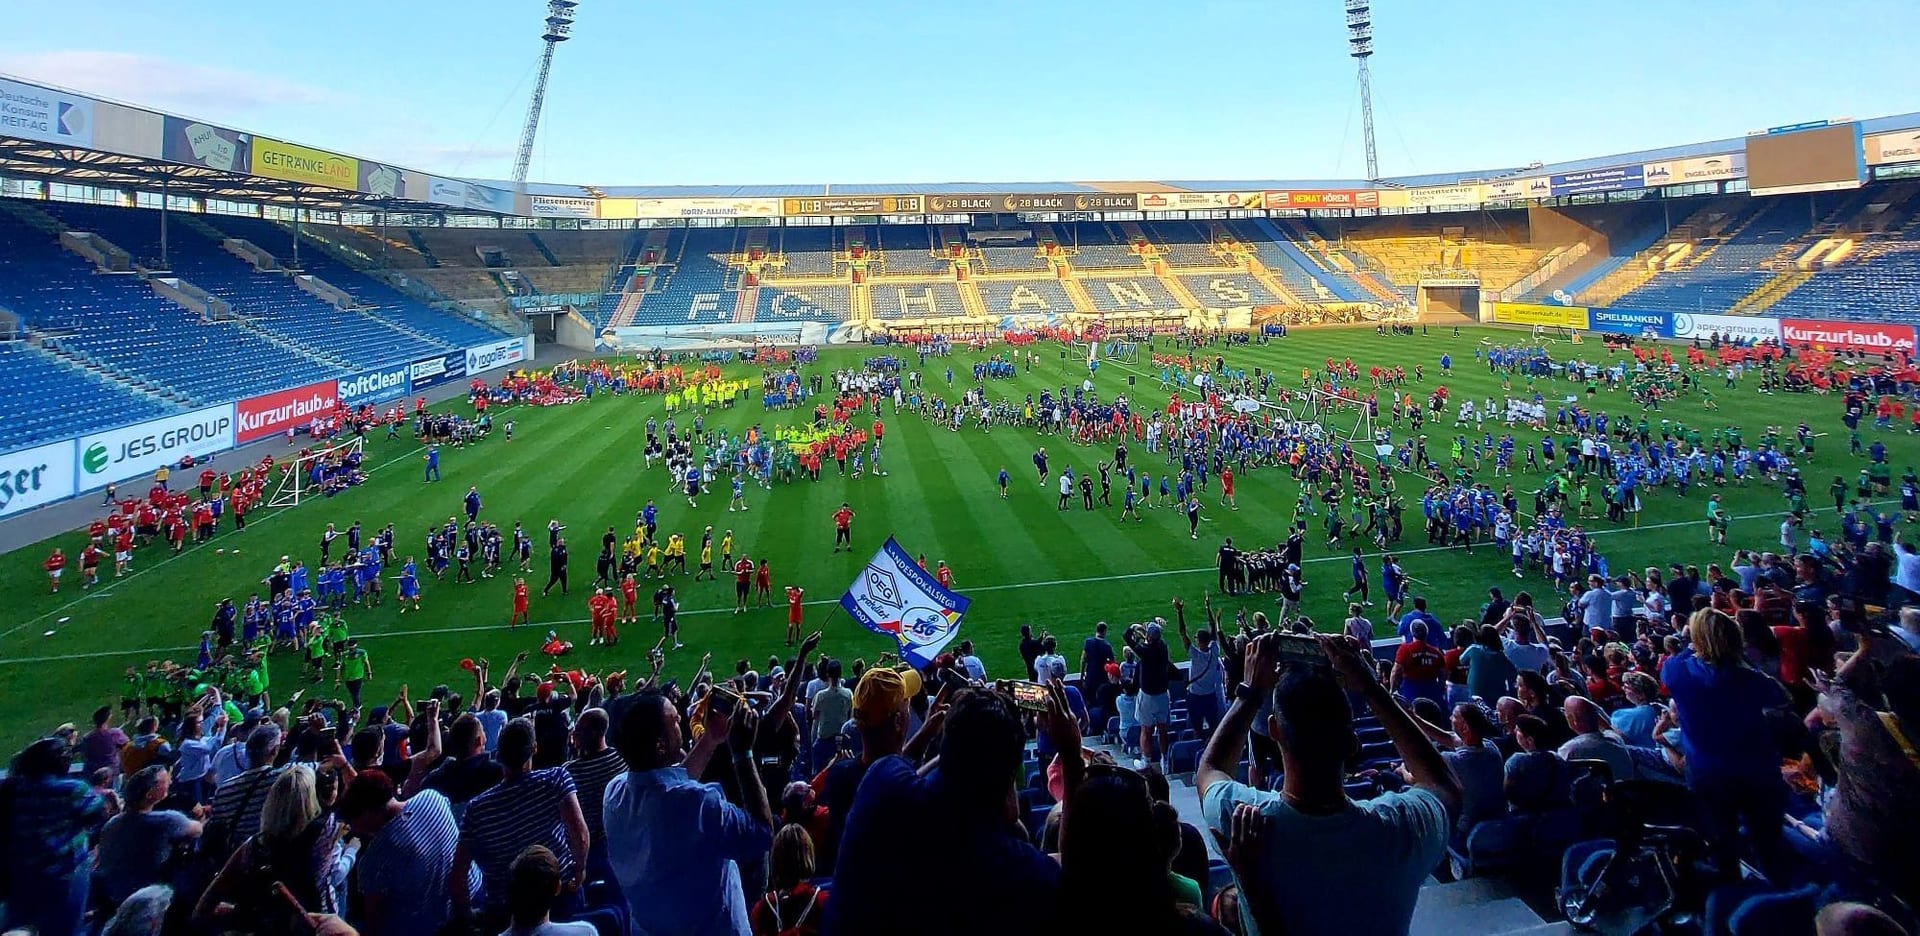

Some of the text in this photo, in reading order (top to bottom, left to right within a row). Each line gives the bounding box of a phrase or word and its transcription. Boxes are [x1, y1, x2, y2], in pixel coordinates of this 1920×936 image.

[2, 103, 48, 120] Konsum
[1, 115, 48, 132] REIT-AG
[263, 151, 351, 178] GETRÄNKELAND
[800, 200, 821, 212] IGB
[897, 199, 918, 211] IGB
[946, 199, 991, 208] 28 BLACK
[1019, 198, 1063, 208] 28 BLACK
[1090, 198, 1133, 207] 28 BLACK
[1293, 194, 1321, 203] HEIMAT
[1595, 312, 1663, 325] SPIELBANKEN
[1697, 322, 1774, 334] apex-group.de
[1784, 326, 1913, 349] Kurzurlaub.de
[238, 394, 335, 433] Kurzurlaub.de
[114, 417, 230, 463] JES.GROUP
[870, 572, 893, 600] OEG
[852, 605, 870, 624] 2007
